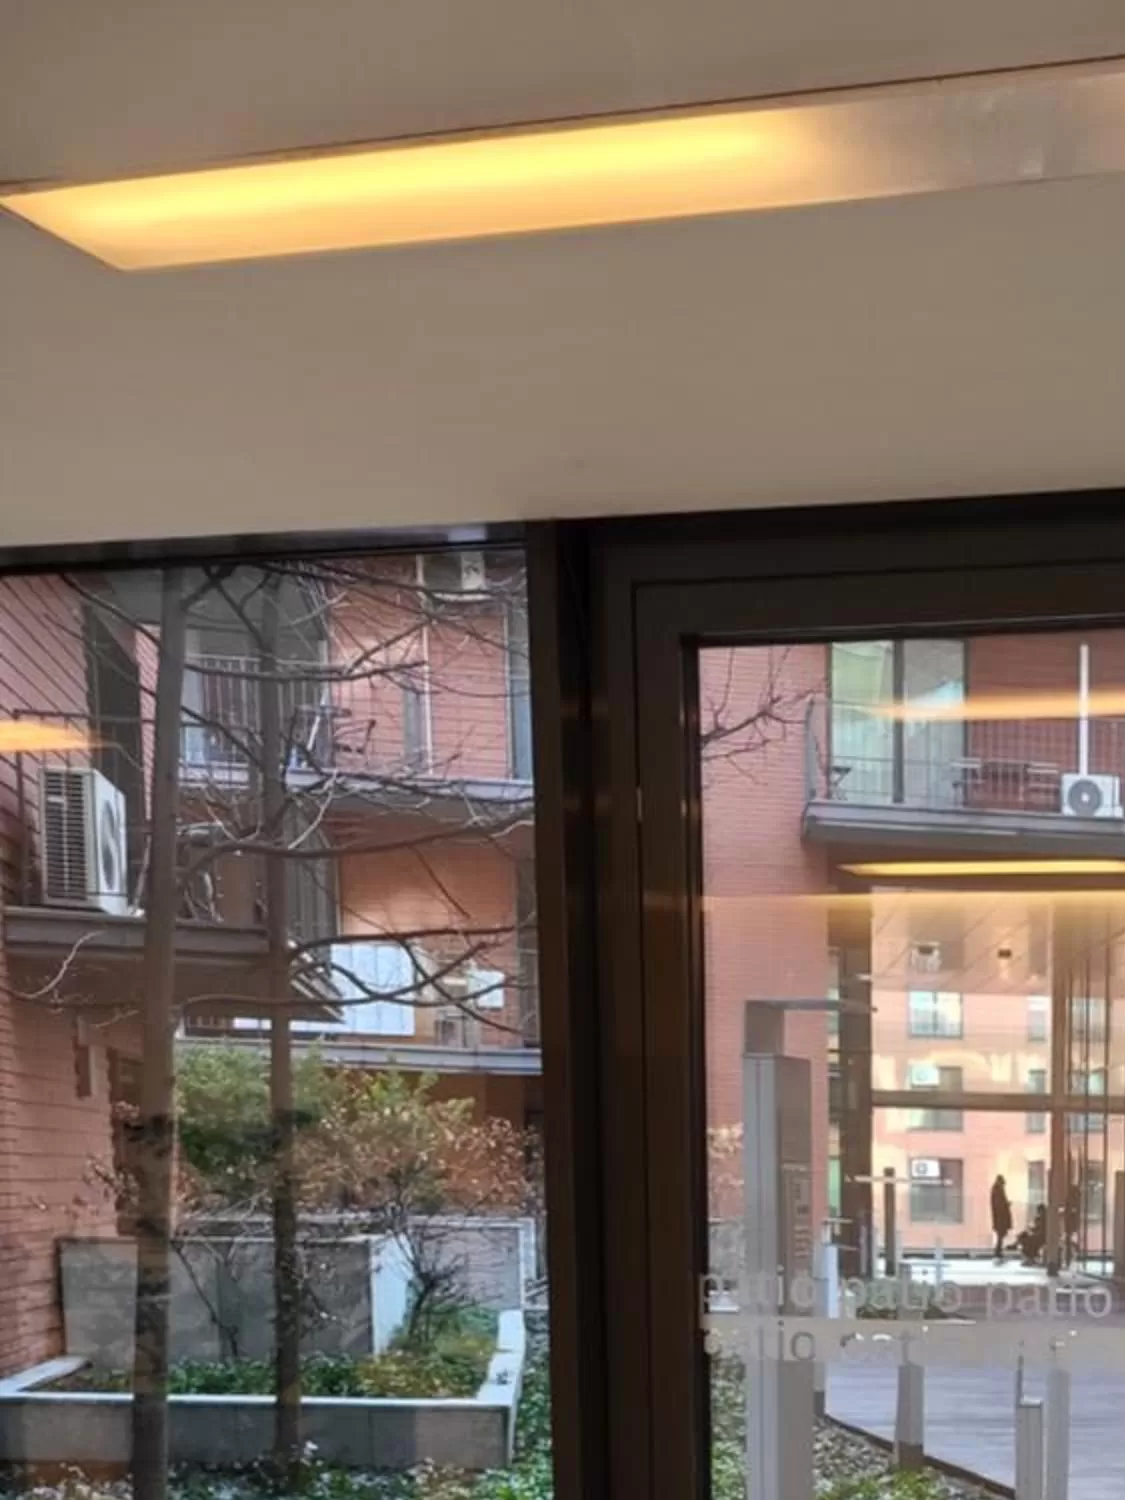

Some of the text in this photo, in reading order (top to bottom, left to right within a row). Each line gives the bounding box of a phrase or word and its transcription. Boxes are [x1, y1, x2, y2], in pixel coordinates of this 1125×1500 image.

[701, 1264, 1113, 1323] ptio patio patio
